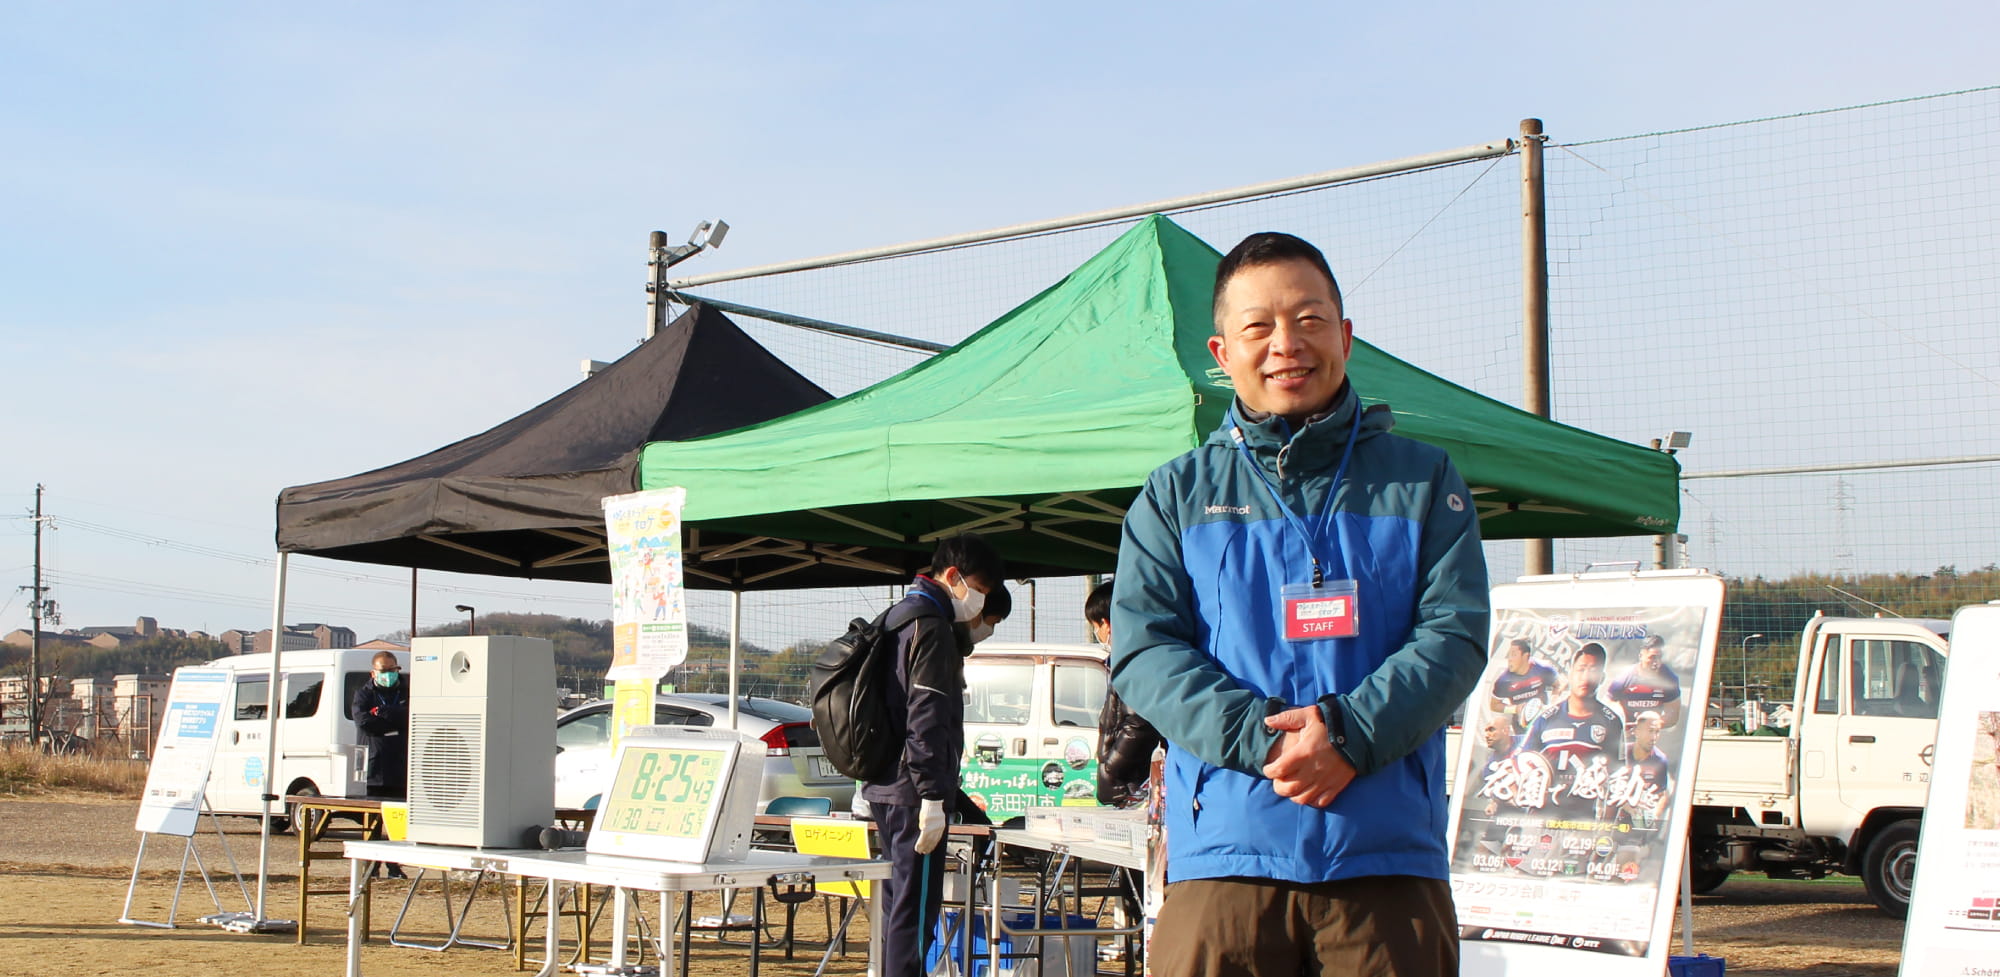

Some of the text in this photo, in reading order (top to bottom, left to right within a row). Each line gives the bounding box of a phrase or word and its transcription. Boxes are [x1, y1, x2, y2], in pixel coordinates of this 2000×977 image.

[1204, 504, 1251, 515] Marmot
[1303, 621, 1334, 633] STAFF
[1576, 621, 1648, 640] LINERS
[631, 753, 700, 803] 8:25
[694, 780, 714, 804] 43
[964, 771, 1037, 789] 魅力いっぱい
[989, 793, 1056, 813] 京田辺市
[804, 828, 853, 842] ロゲイニング
[1505, 833, 1533, 846] 01.22
[1562, 837, 1592, 851] 02.19
[1473, 856, 1500, 868] 03.06
[1531, 859, 1558, 872] 03.12
[1587, 862, 1616, 875] 04.01
